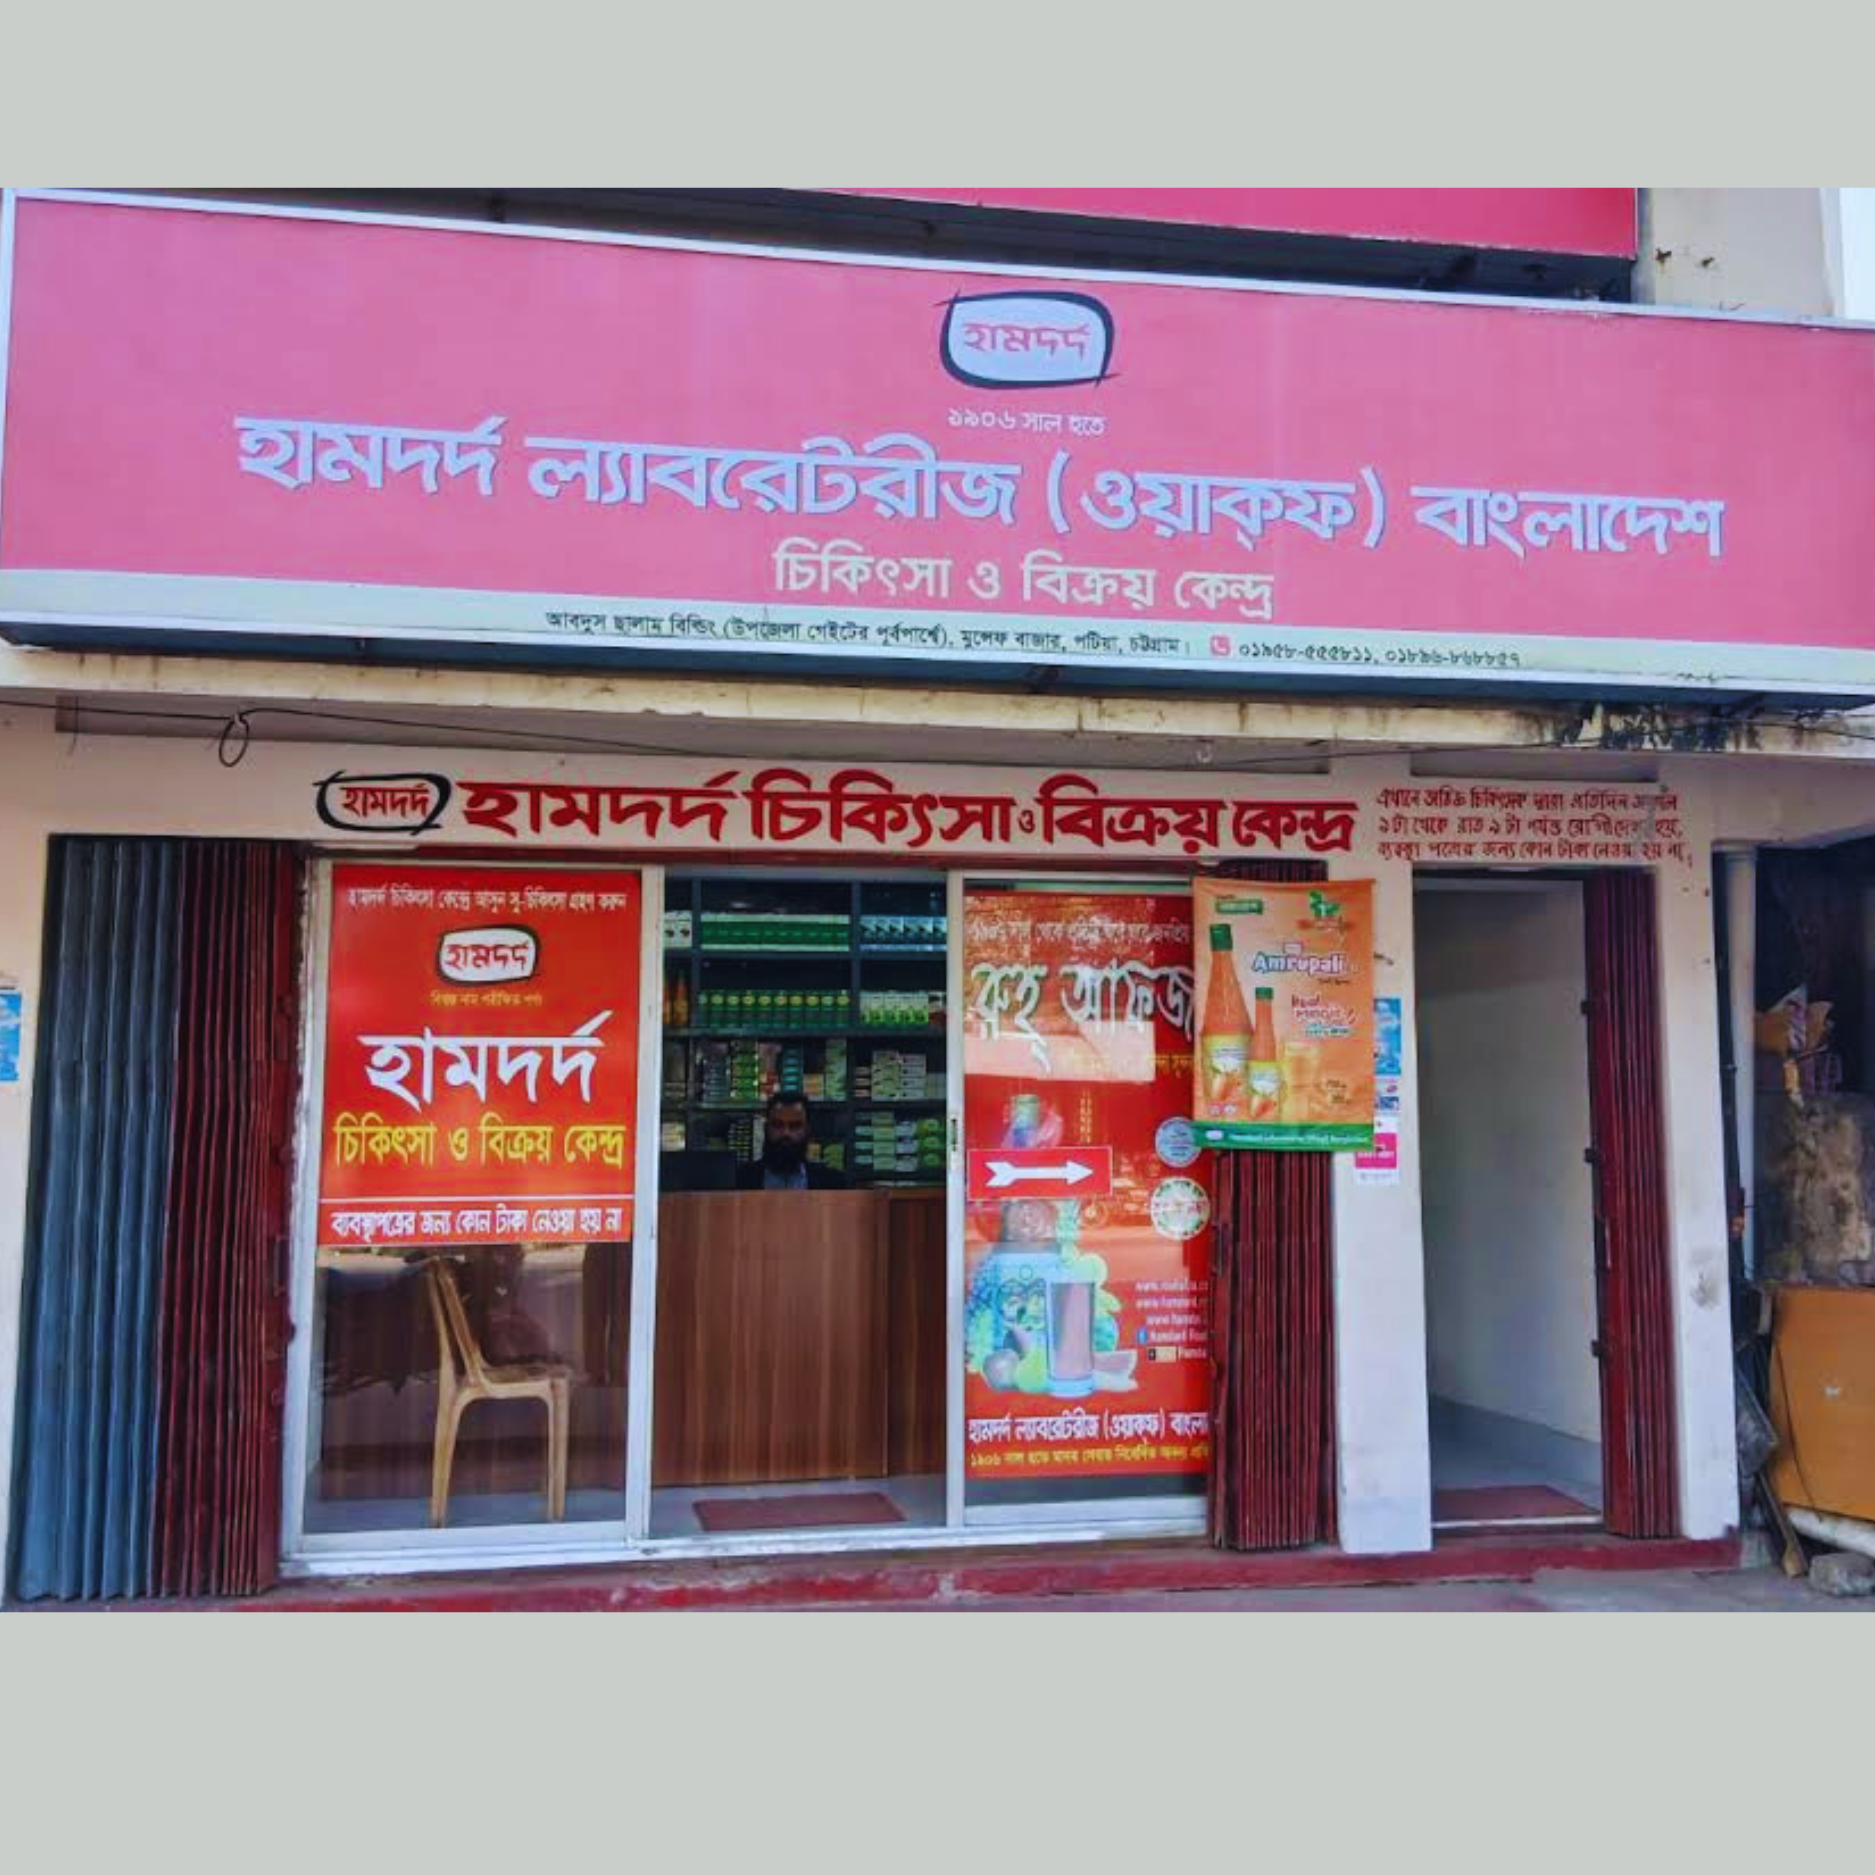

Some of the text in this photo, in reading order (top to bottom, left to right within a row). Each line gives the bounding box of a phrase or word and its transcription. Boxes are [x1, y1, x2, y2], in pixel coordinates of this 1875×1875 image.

[962, 323, 1091, 360] হামদর্দ
[948, 407, 1016, 429] ১৯০৬
[1021, 411, 1063, 433] সাল
[233, 415, 508, 498] হামদর্দ
[524, 433, 1022, 526] ল্যাবরেটরীজ
[1410, 484, 1726, 562] বাংলাদেশ
[772, 536, 1275, 620] চিকিৎসা ও বিক্রয় কেন্দ্র
[546, 611, 606, 635] আবদুস
[612, 615, 663, 636] ছালাম
[722, 615, 801, 641] (উপজেলা
[807, 620, 868, 642] গেইটের
[1014, 630, 1066, 652] বাজার,
[339, 767, 1358, 854] হামদর্দ হামদর্দ চিকিৎসা ও বিক্রয় কেন্দ্র
[444, 941, 530, 971] হামদর্দ
[357, 1009, 614, 1114] হামদর্দ
[333, 1111, 627, 1170] চিকিৎসা ও বিক্রয় কেন্দ্র
[420, 1209, 451, 1236] জন্য
[455, 1208, 492, 1235] কোন
[496, 1203, 529, 1234] টাকা
[532, 1208, 576, 1236] নেওয়া
[579, 1208, 602, 1234] হয়
[605, 1206, 623, 1233] না
[968, 1412, 1011, 1443] হামদর্দ
